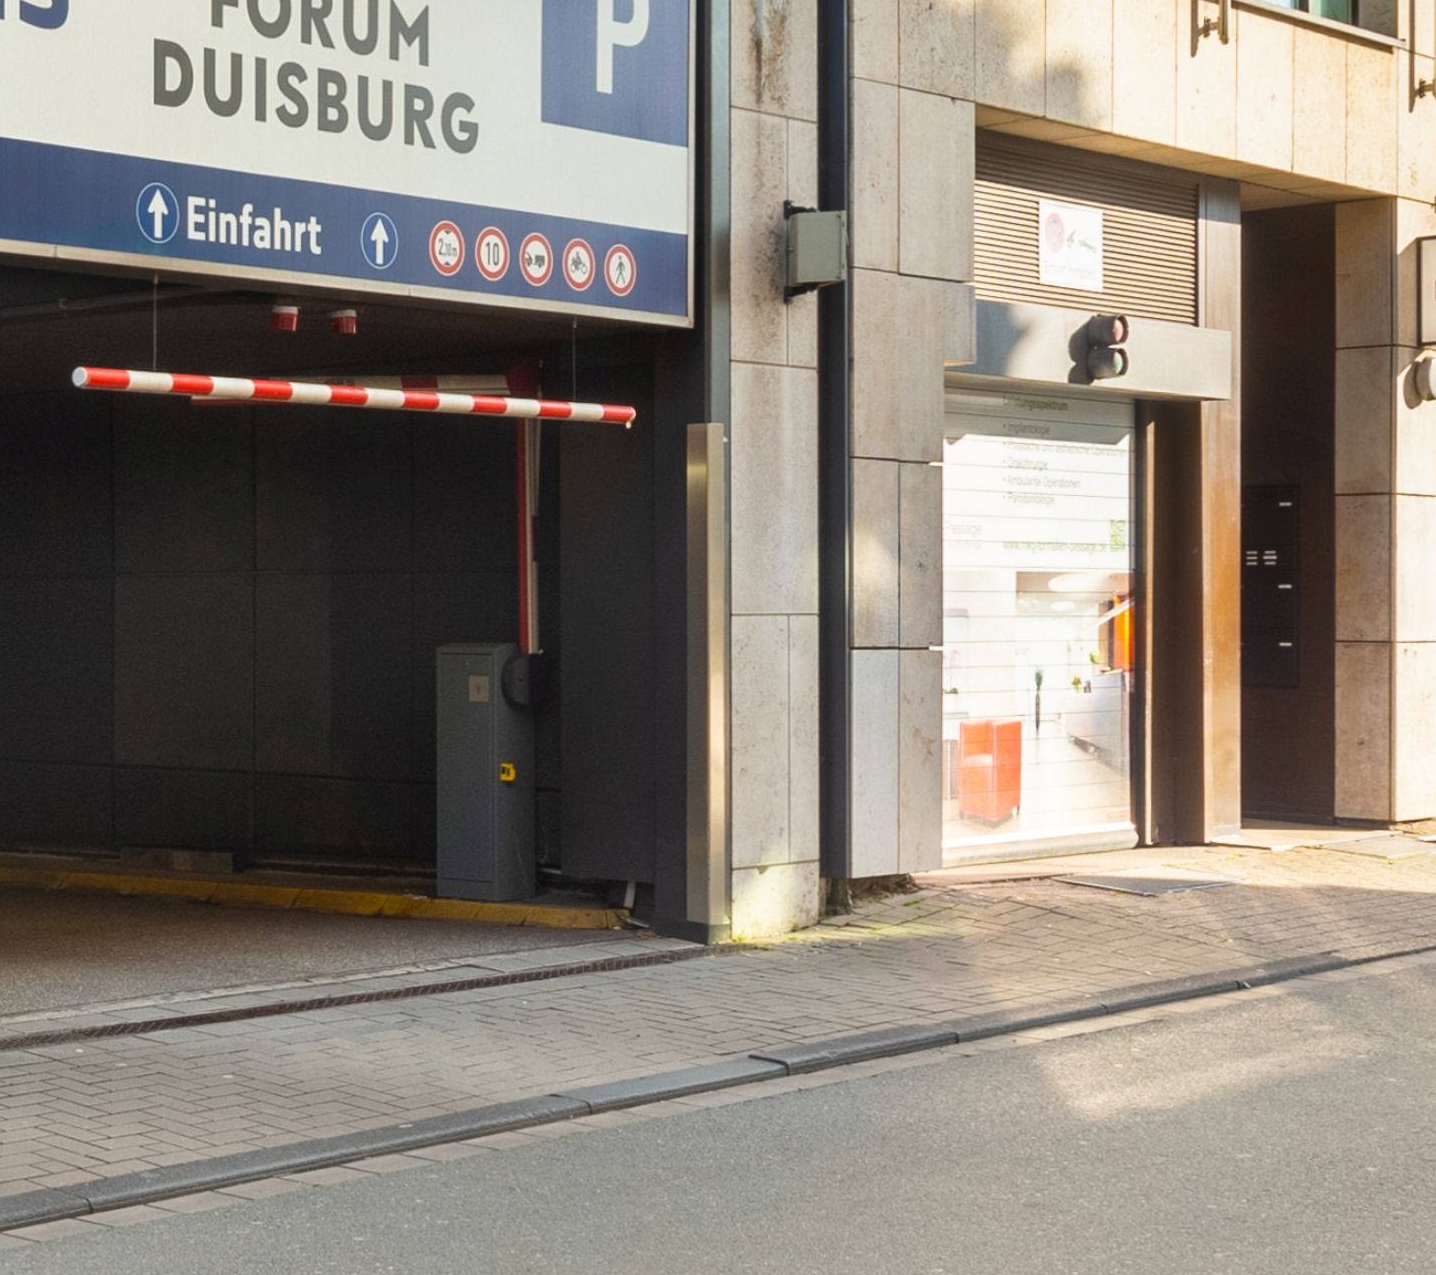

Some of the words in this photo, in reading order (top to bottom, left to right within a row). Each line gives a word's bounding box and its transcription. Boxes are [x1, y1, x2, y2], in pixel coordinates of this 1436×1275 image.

[152, 37, 480, 155] DUISBURG
[186, 195, 323, 256] Einfahrt
[485, 241, 500, 267] 10
